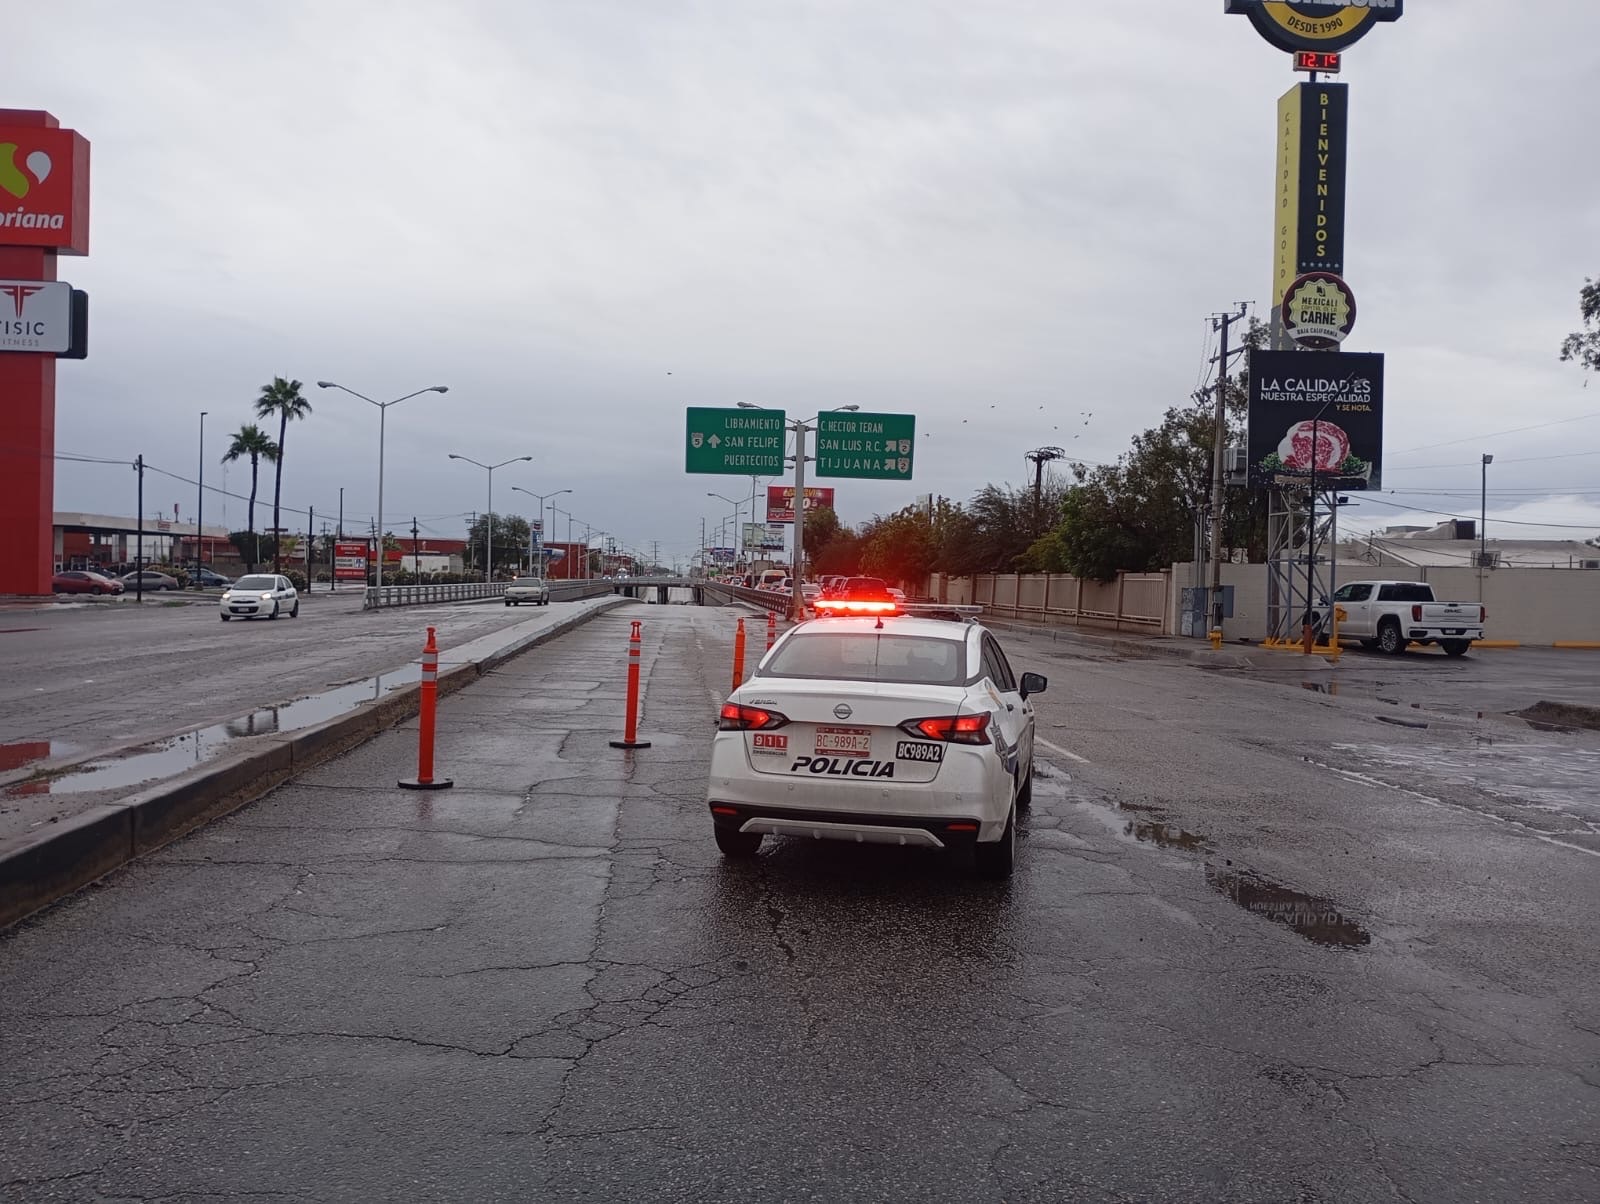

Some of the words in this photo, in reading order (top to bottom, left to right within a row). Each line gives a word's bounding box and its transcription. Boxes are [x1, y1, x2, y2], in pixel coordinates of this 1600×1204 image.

[1287, 15, 1318, 34] DESDE
[1320, 18, 1344, 33] 1990
[1282, 112, 1290, 209] CALIDAD
[1315, 93, 1329, 257] BIENVENIDOS
[1280, 225, 1288, 279] GOLD
[1301, 296, 1338, 307] MEXICALI
[1300, 310, 1337, 325] CARNE
[0, 321, 45, 336] ISIC
[1309, 327, 1338, 338] CALIFORNIA
[1261, 377, 1281, 391] LA
[1284, 378, 1350, 393] CALIDAD
[1353, 379, 1371, 393] ES
[1260, 392, 1304, 401] NUESTRA
[1306, 392, 1371, 403] ESPECIALIDAD
[725, 417, 780, 430] LIBRAMIENTO
[828, 421, 856, 433] HECTOR
[859, 422, 883, 433] TERAN
[724, 436, 744, 448] SAN
[747, 436, 779, 448] FELIPE
[820, 439, 839, 450] SAN
[842, 439, 862, 451] LUIS
[724, 454, 779, 467] PUERTECITOS
[820, 457, 881, 470] TIJUANA
[755, 735, 785, 746] 911
[816, 734, 869, 749] BC-989A-2
[897, 742, 940, 760] BC989A2
[790, 756, 895, 778] POLICIA
